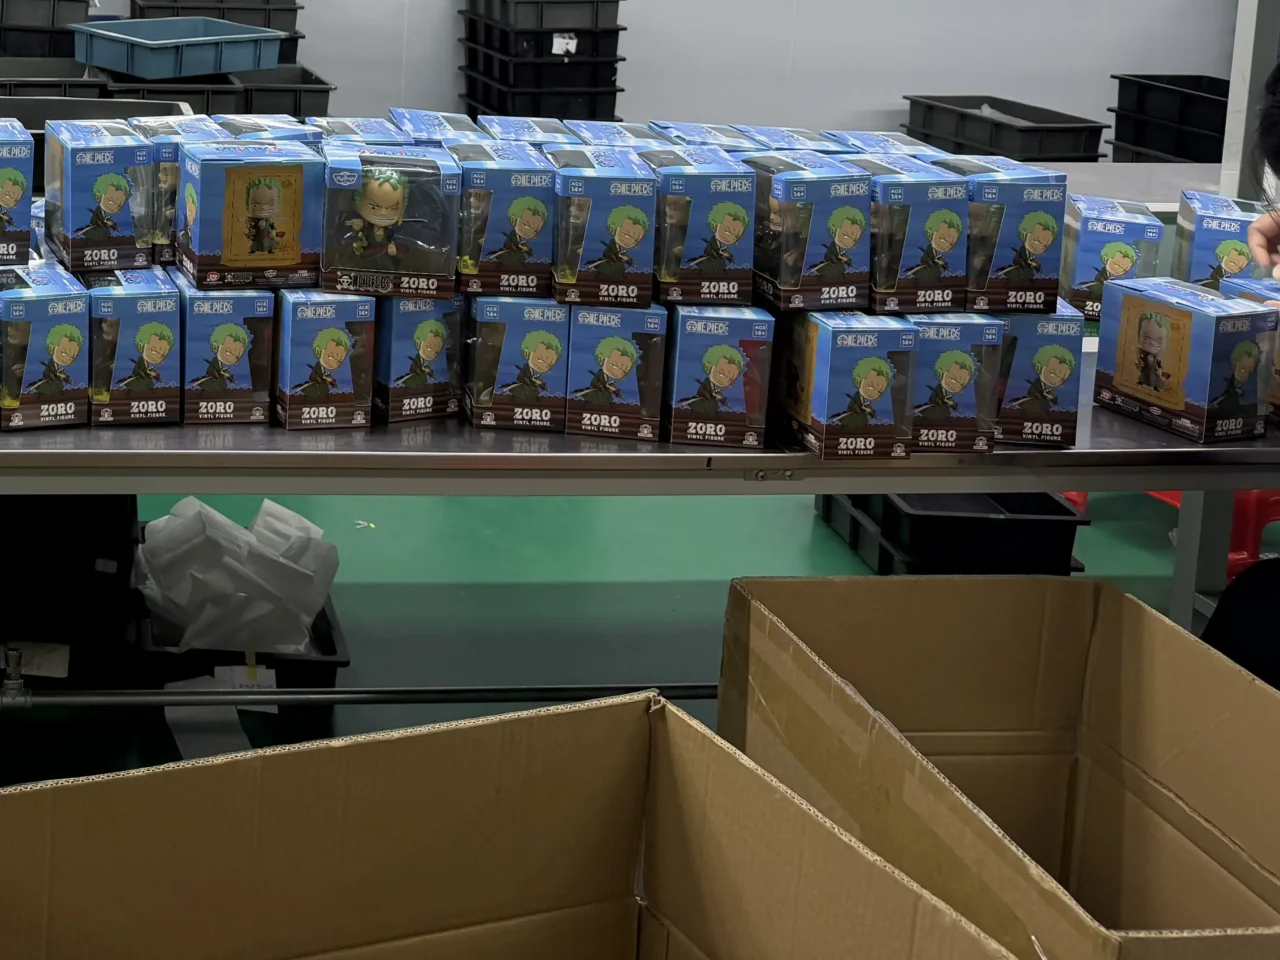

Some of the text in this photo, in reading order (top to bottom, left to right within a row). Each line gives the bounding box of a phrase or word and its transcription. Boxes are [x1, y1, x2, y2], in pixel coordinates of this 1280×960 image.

[84, 250, 117, 260] ZORO
[400, 277, 437, 289] ZORO
[500, 275, 537, 286] ZORO
[599, 285, 638, 296] ZORO
[701, 282, 738, 293] ZORO
[821, 287, 856, 298] ZORO
[917, 290, 953, 302] ZORO
[1007, 292, 1045, 303] ZORO
[1086, 302, 1100, 311] ZO
[131, 401, 166, 412] ZORO
[199, 402, 234, 412] ZORO
[402, 397, 433, 409] ZORO
[40, 403, 75, 416] ZORO
[302, 407, 336, 418] ZORO
[514, 408, 551, 420] ZORO
[582, 413, 620, 427] ZORO
[1216, 419, 1242, 430] ZORO
[687, 423, 725, 435] ZORO
[1023, 423, 1062, 435] ZORO
[919, 429, 957, 441] ZORO
[838, 438, 874, 449] ZORO
